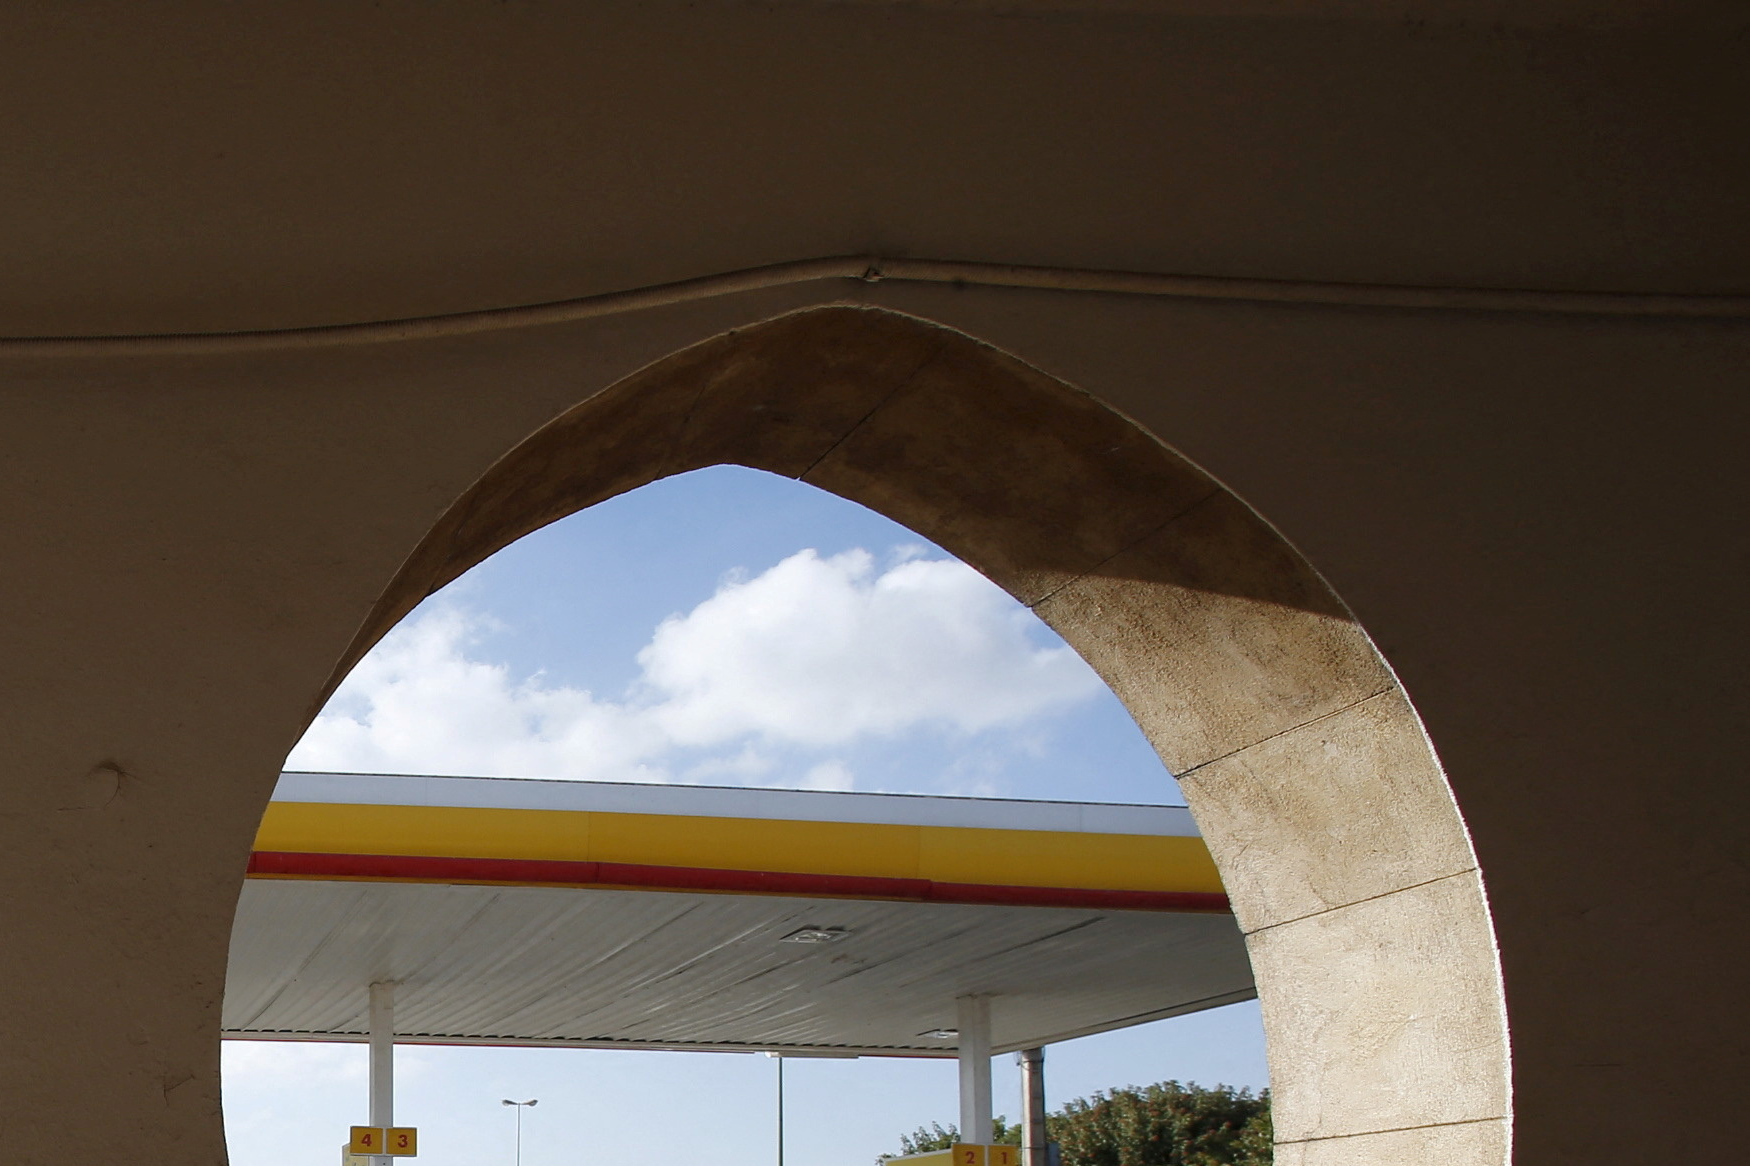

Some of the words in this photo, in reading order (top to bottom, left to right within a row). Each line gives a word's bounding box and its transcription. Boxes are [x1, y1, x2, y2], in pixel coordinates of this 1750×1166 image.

[361, 1133, 372, 1147] 4
[397, 1134, 408, 1148] 3
[965, 1151, 975, 1164] 2
[1001, 1152, 1007, 1164] 1
